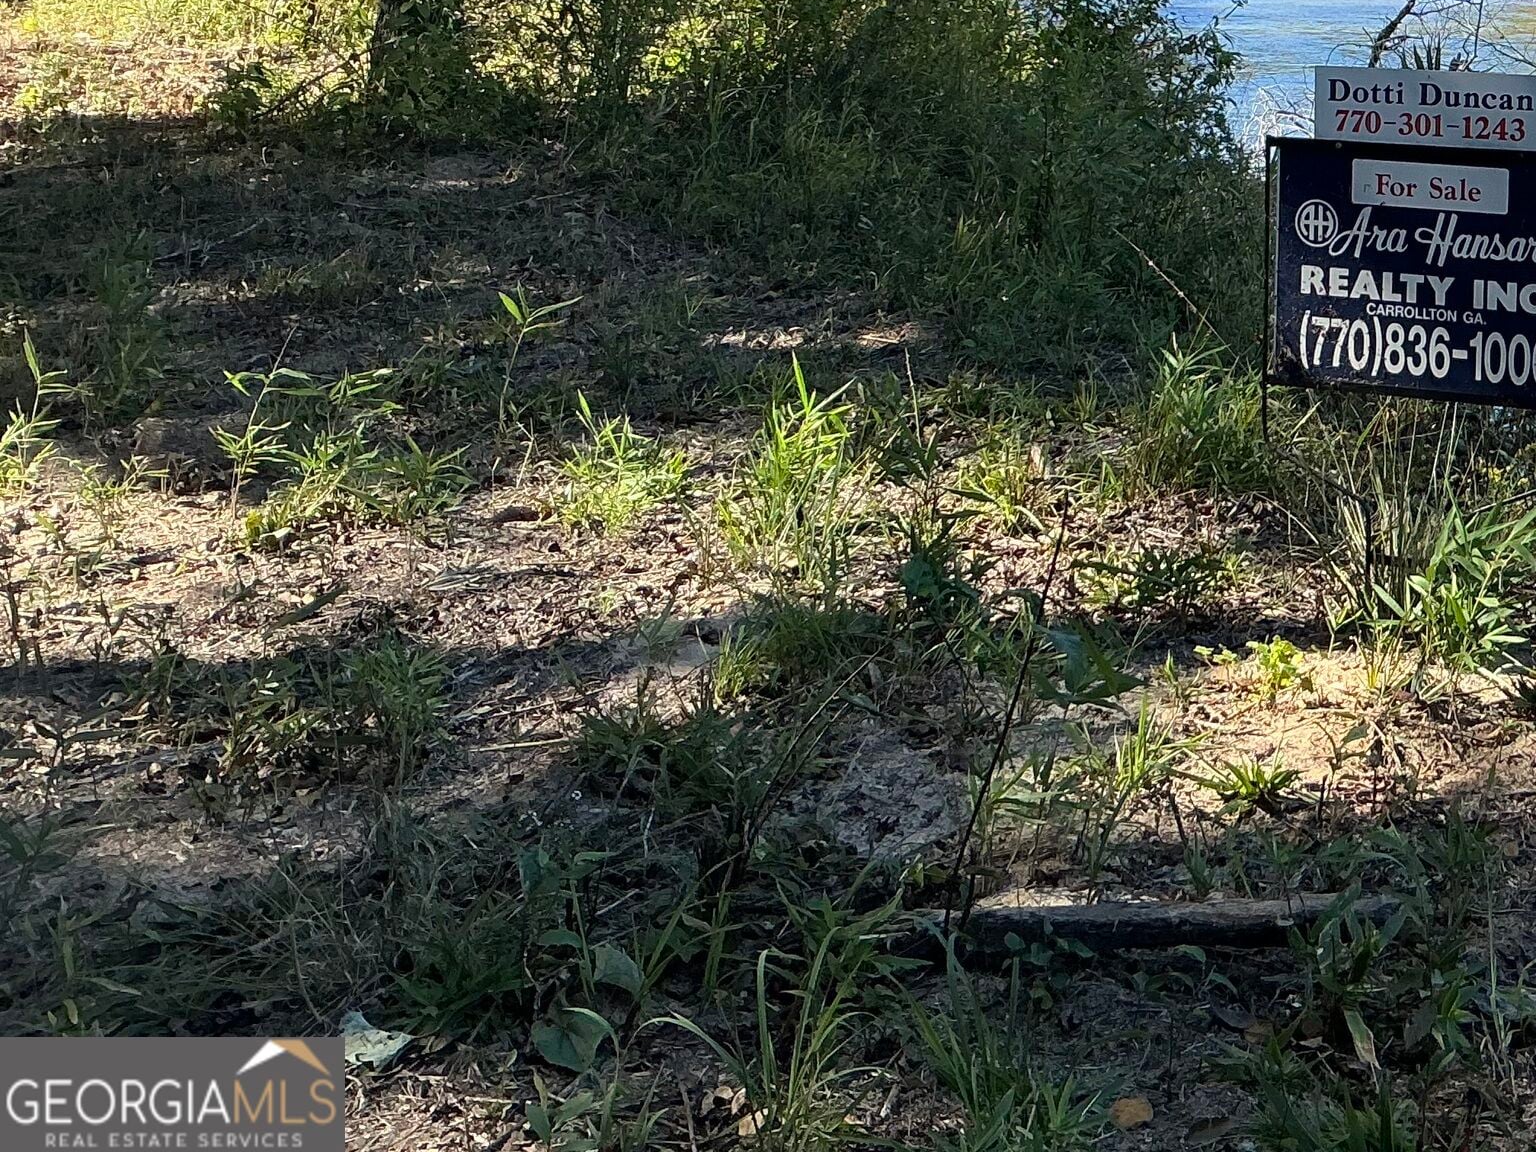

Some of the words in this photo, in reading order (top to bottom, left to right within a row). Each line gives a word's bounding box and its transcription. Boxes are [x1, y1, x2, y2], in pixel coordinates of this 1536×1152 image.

[1328, 78, 1404, 105] Dotti
[1418, 83, 1535, 111] Duncan
[1335, 109, 1526, 142] 770-301-1243
[1375, 174, 1418, 198] For
[1429, 176, 1482, 202] Sale
[1329, 206, 1408, 258] Ara
[1300, 264, 1455, 304] REALTY
[1366, 302, 1457, 323] CARROLLTON
[1463, 311, 1487, 326] GA.
